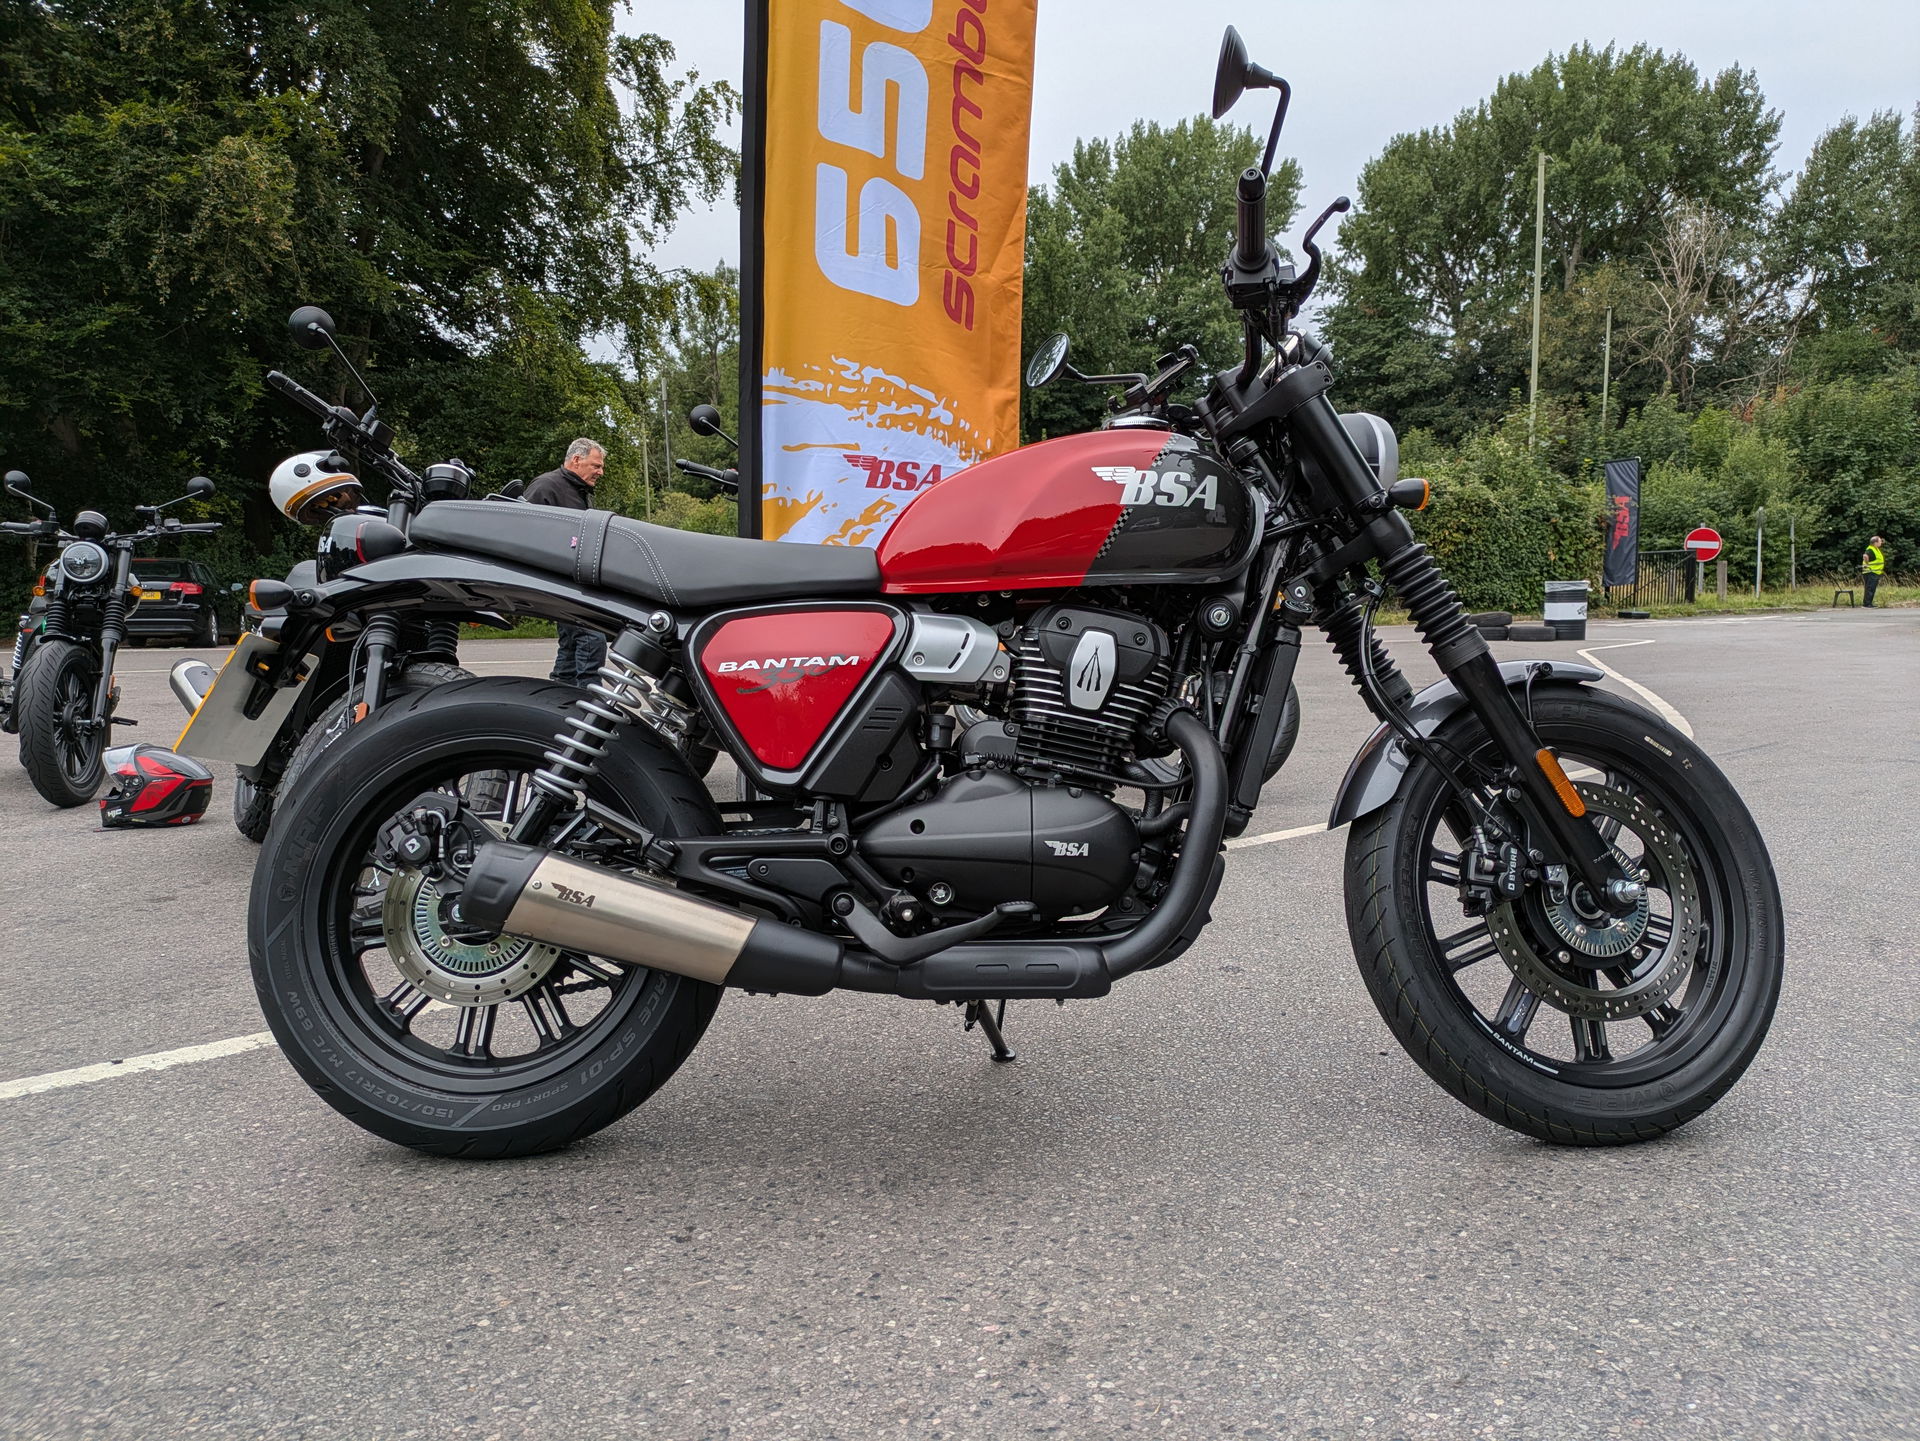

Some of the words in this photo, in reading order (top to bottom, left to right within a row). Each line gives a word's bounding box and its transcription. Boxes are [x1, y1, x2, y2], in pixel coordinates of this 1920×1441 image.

[815, 0, 933, 306] 65
[943, 0, 987, 331] scramb
[865, 456, 942, 492] BSA
[1120, 469, 1218, 511] BSA
[717, 655, 860, 673] BANTAM
[1053, 841, 1089, 857] BSA
[556, 885, 597, 909] BSA
[1492, 1032, 1535, 1065] BANTAM
[491, 1098, 522, 1113] PRO
[523, 1081, 569, 1106] SPORT
